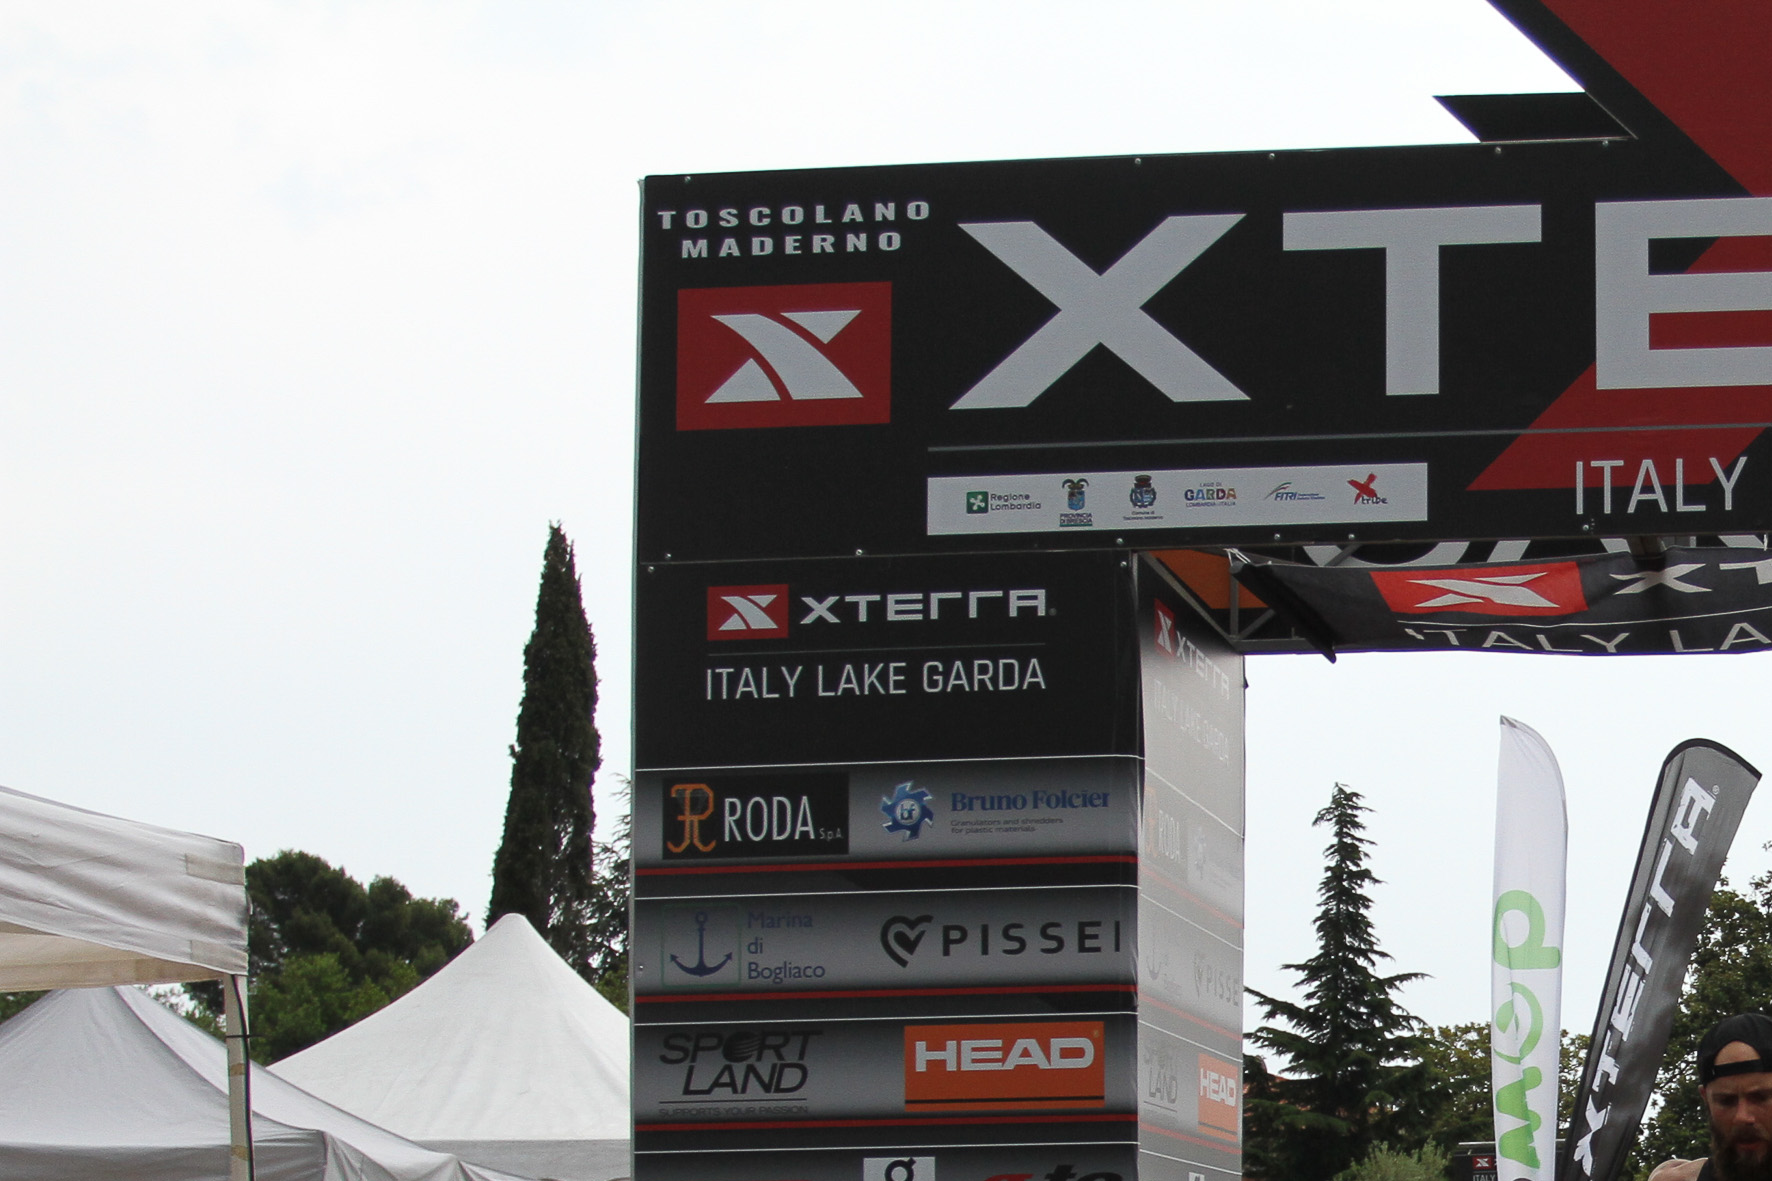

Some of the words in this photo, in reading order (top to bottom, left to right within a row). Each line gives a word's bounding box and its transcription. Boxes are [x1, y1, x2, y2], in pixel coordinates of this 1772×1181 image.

[658, 201, 931, 230] TOSCOLANO
[681, 232, 903, 259] MADERNO
[990, 492, 1031, 503] Regione
[1184, 488, 1237, 501] GARDA
[1575, 457, 1750, 516] ITALY
[990, 501, 1042, 511] Lombardia
[800, 589, 1047, 625] XTERRA
[706, 666, 803, 701] ITALY
[817, 663, 907, 696] LAKE
[922, 659, 1046, 694] GARDA
[951, 790, 1027, 812] Bruno
[723, 796, 816, 843] RODA
[942, 920, 1122, 957] PISSEI
[915, 1037, 1095, 1072] HEAD
[1200, 1067, 1237, 1107] HEAD
[760, 1105, 809, 1116] PASSION
